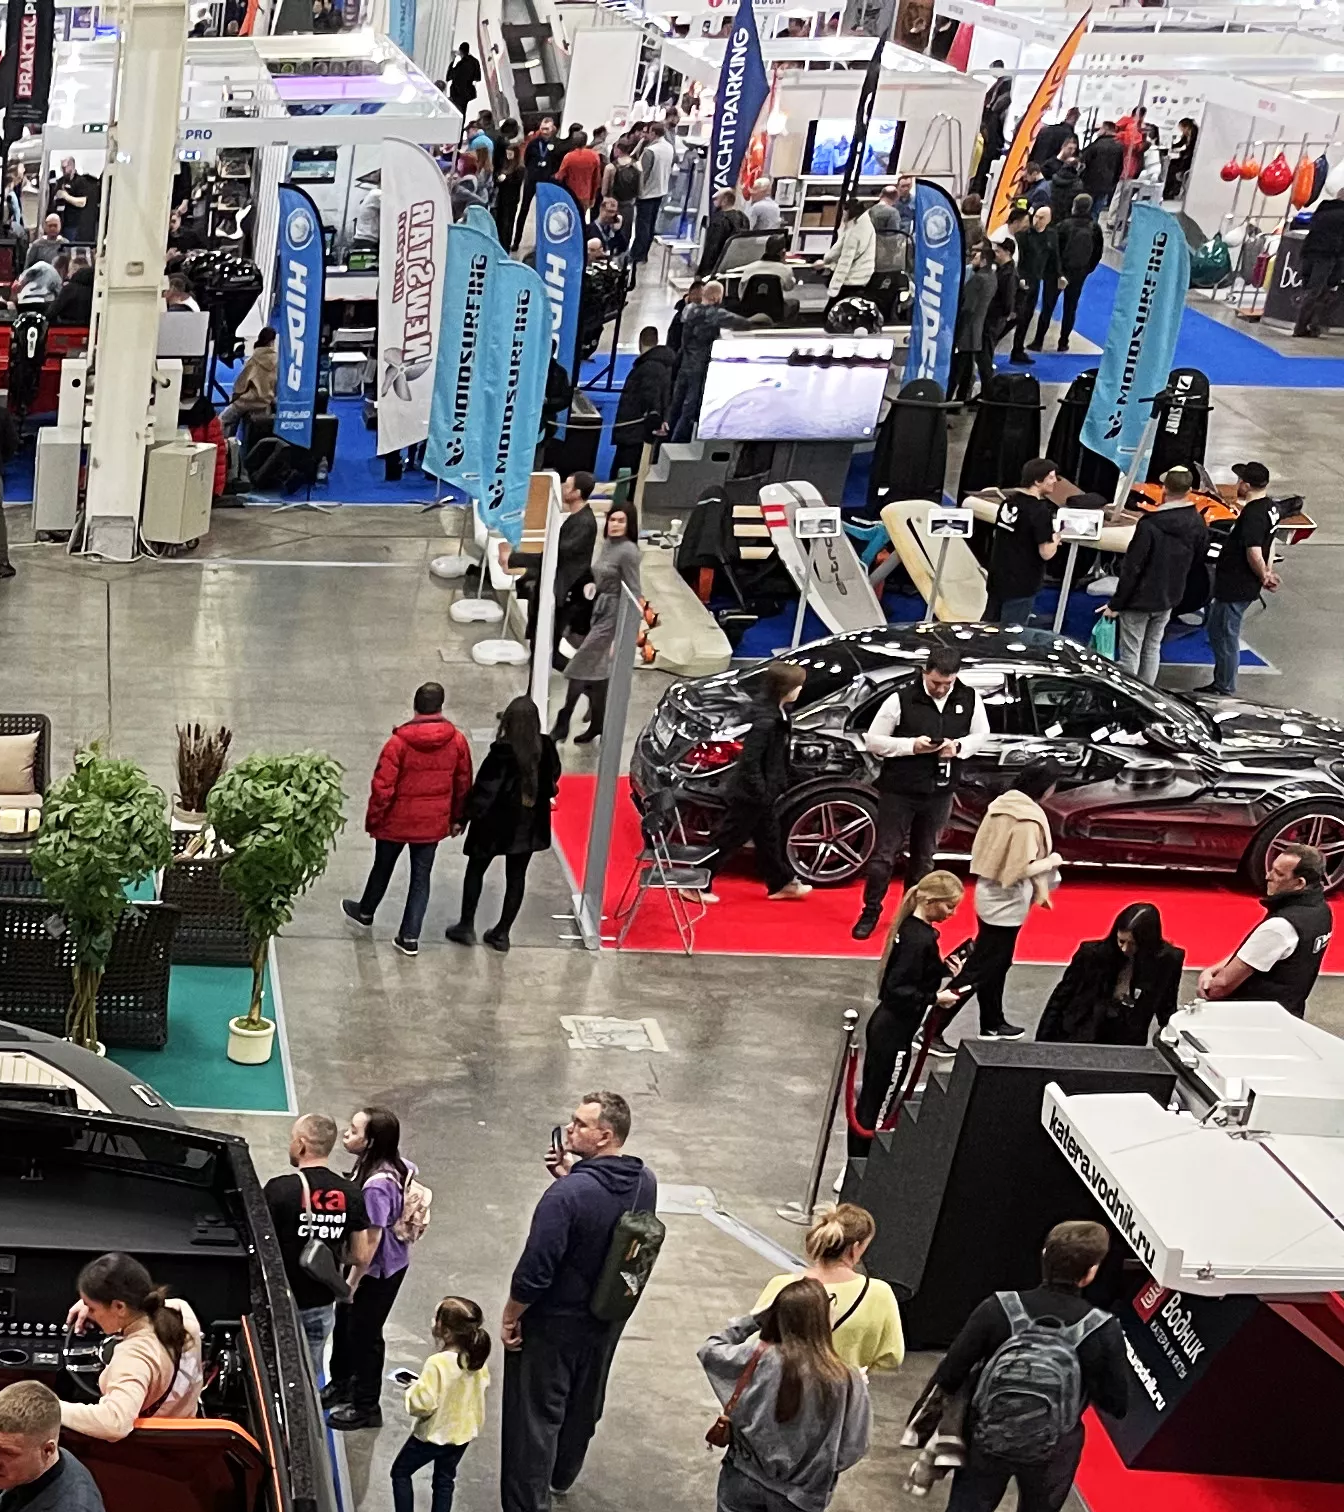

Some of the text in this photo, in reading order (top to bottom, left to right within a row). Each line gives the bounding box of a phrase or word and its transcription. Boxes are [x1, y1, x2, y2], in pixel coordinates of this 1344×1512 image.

[18, 0, 37, 97] PRAKTIK.P
[453, 253, 488, 431] MOTOSURFING
[494, 287, 530, 473] MOTOSURFING
[1118, 231, 1168, 406] MOTOSURFING
[298, 1225, 344, 1239] crew
[1049, 1105, 1157, 1269] katera.vodnik.ru
[1160, 1292, 1207, 1364] Водник
